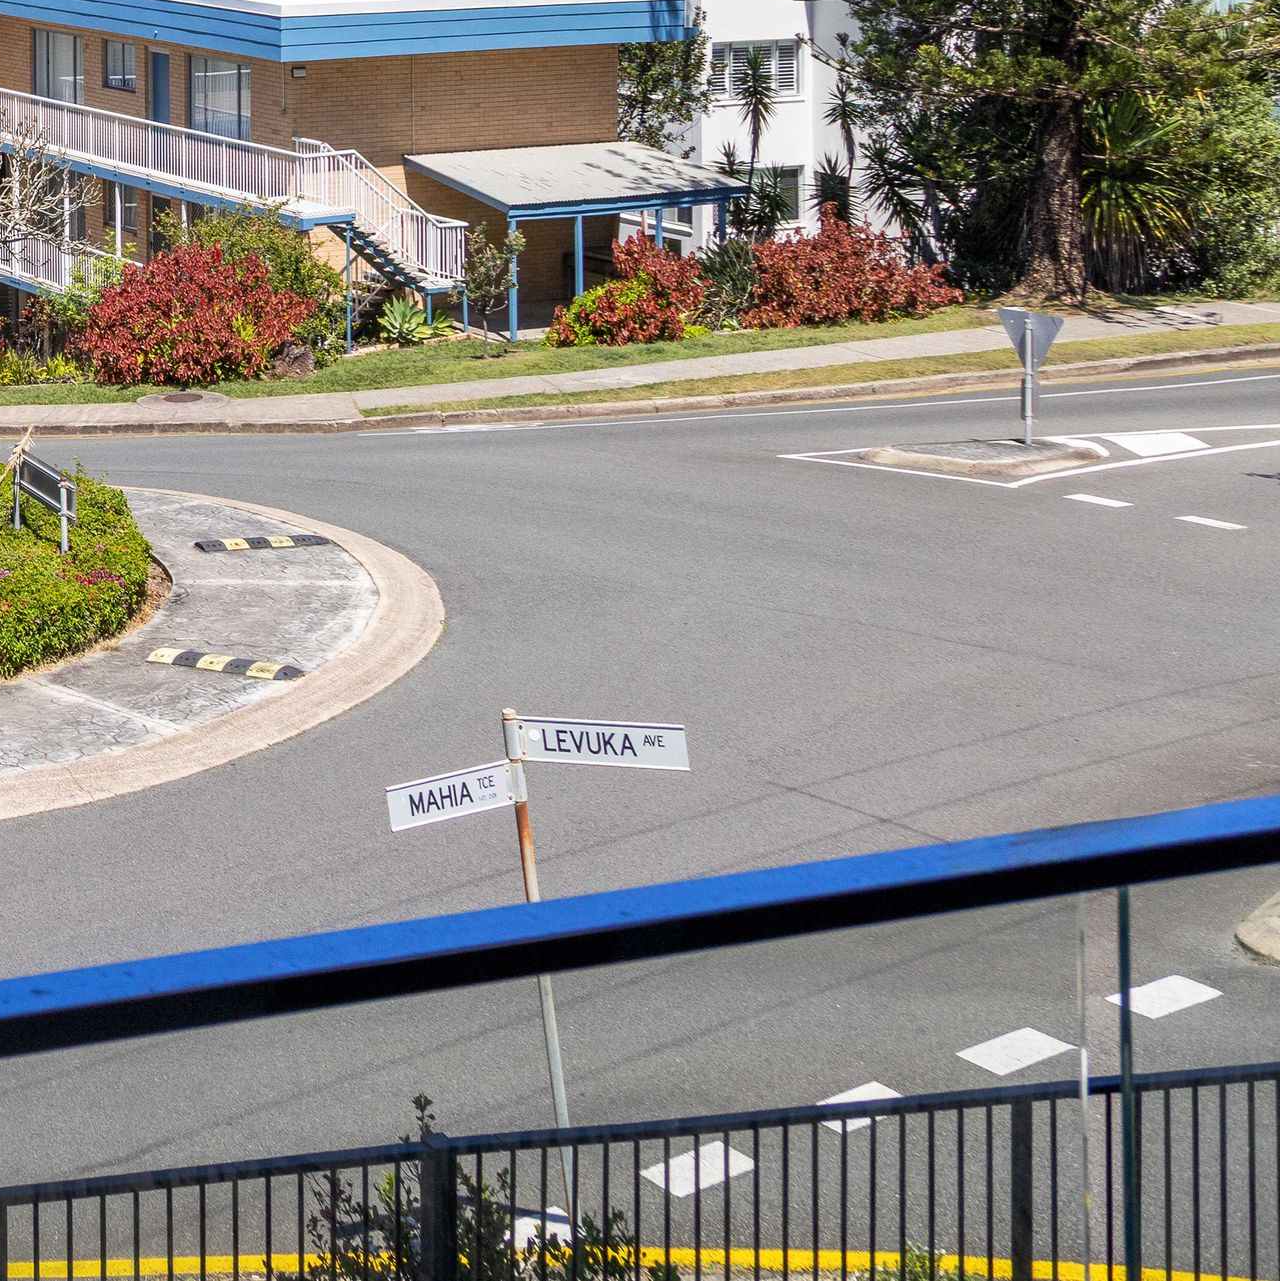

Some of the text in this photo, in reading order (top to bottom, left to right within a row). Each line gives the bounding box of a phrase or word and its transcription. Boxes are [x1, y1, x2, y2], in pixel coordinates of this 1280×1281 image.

[541, 728, 666, 757] LEVUKA AVE
[408, 775, 496, 817] MAHIA TCE
